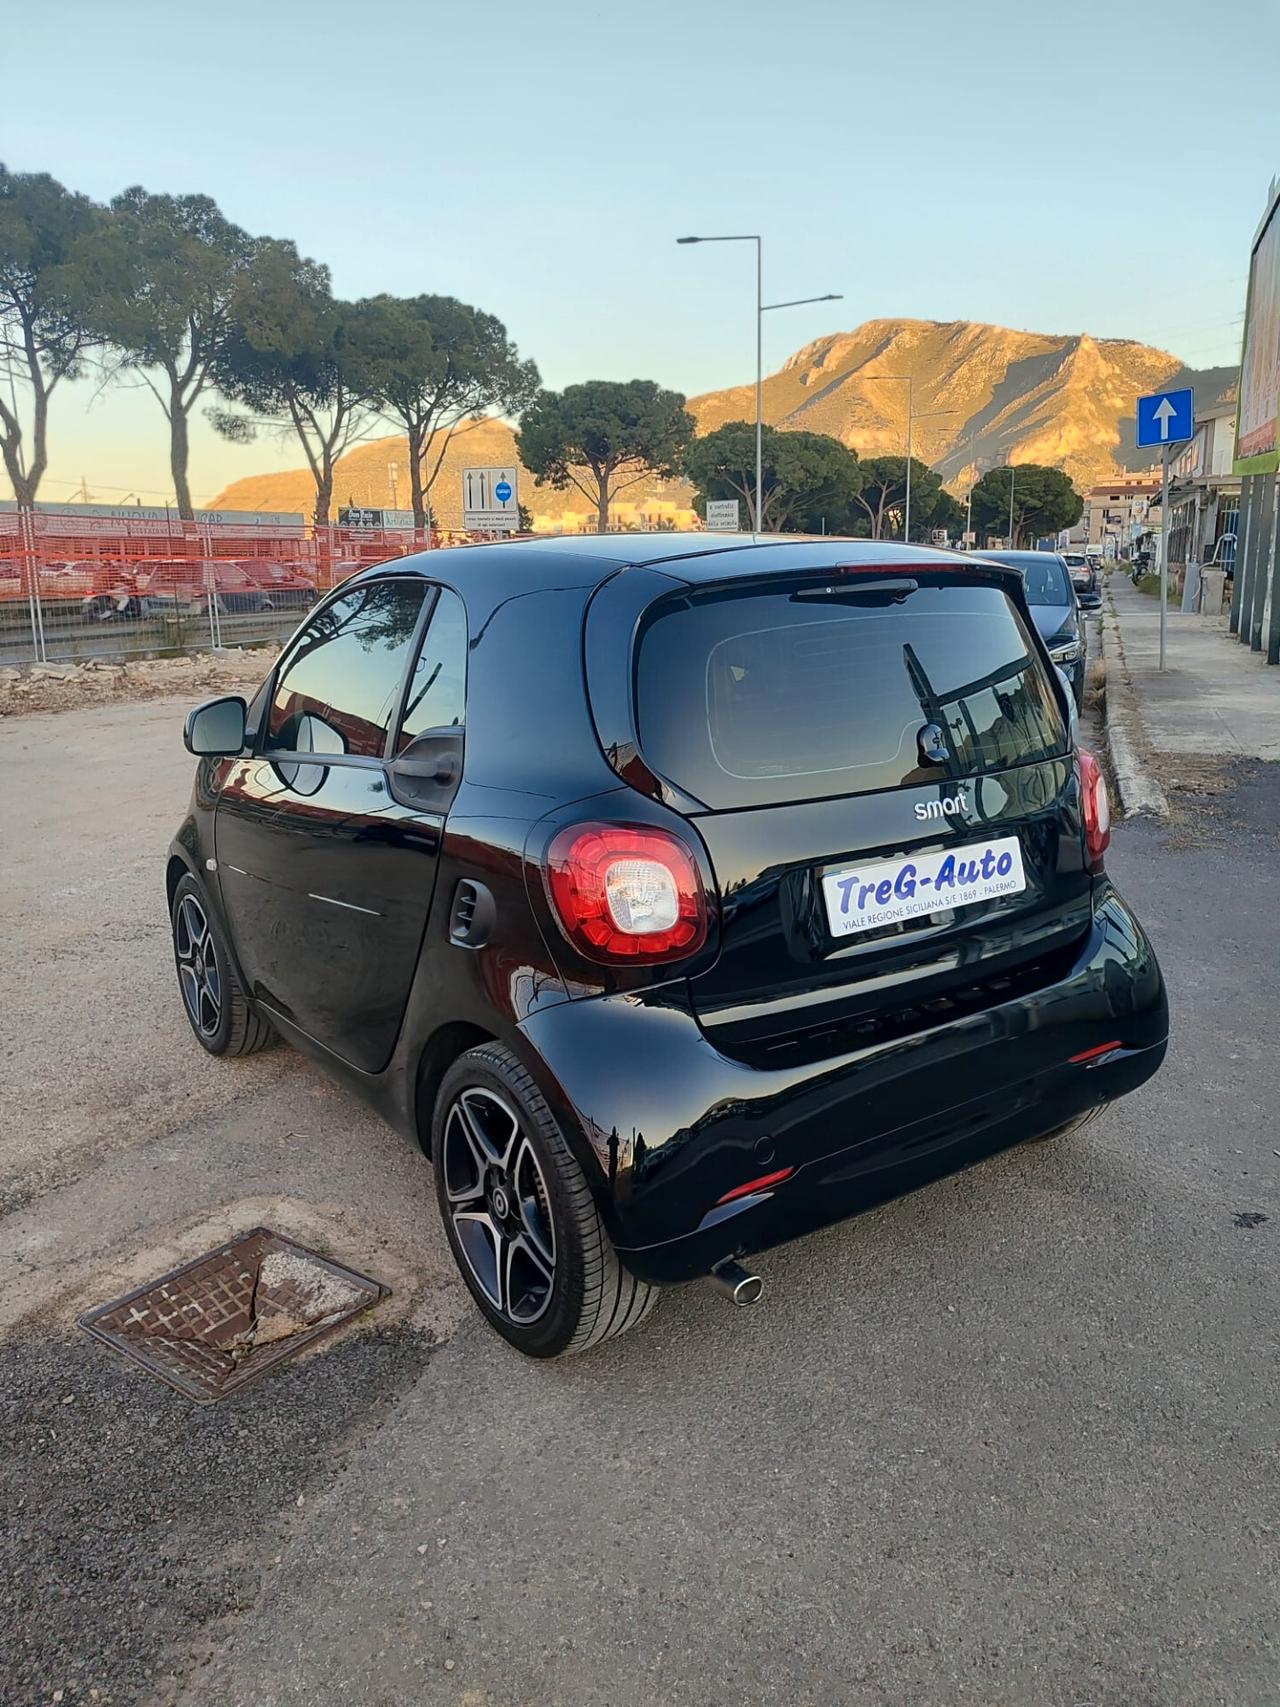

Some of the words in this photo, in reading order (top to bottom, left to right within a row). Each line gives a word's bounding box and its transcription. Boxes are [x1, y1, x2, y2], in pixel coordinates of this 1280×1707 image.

[914, 792, 969, 821] smart
[837, 848, 1013, 915] TreG-Auto
[843, 916, 866, 930] VIALE
[867, 907, 905, 926] REGIONE
[905, 898, 944, 916] SICILIANA
[959, 889, 977, 902] 1869
[984, 880, 1017, 896] PALERMO
